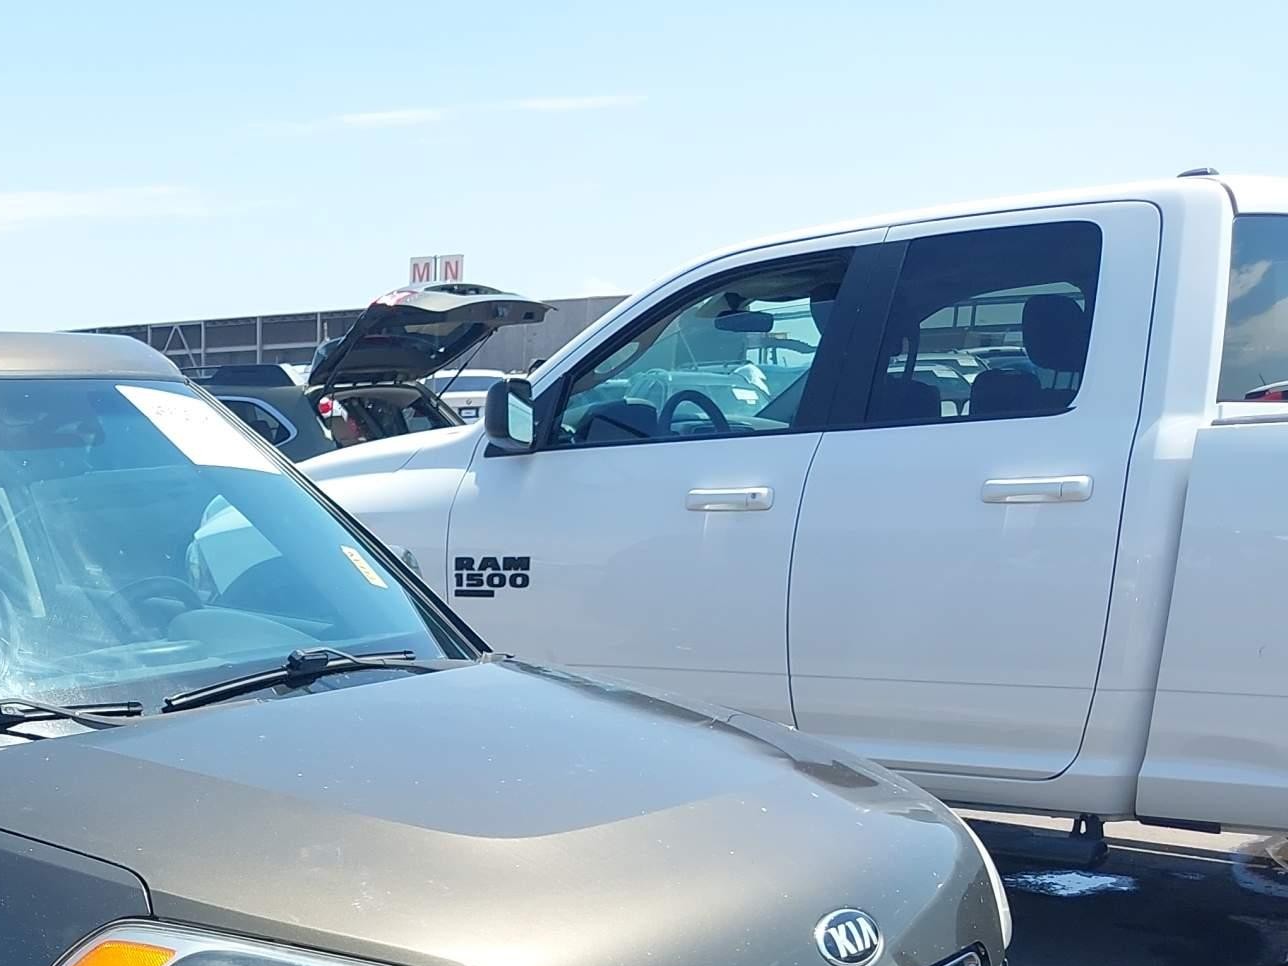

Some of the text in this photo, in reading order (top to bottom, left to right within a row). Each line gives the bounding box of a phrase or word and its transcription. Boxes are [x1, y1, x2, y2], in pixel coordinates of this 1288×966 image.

[413, 262, 430, 283] M
[445, 260, 458, 281] N
[455, 556, 530, 571] RAM
[454, 573, 530, 588] 1500
[827, 917, 878, 959] KIA
